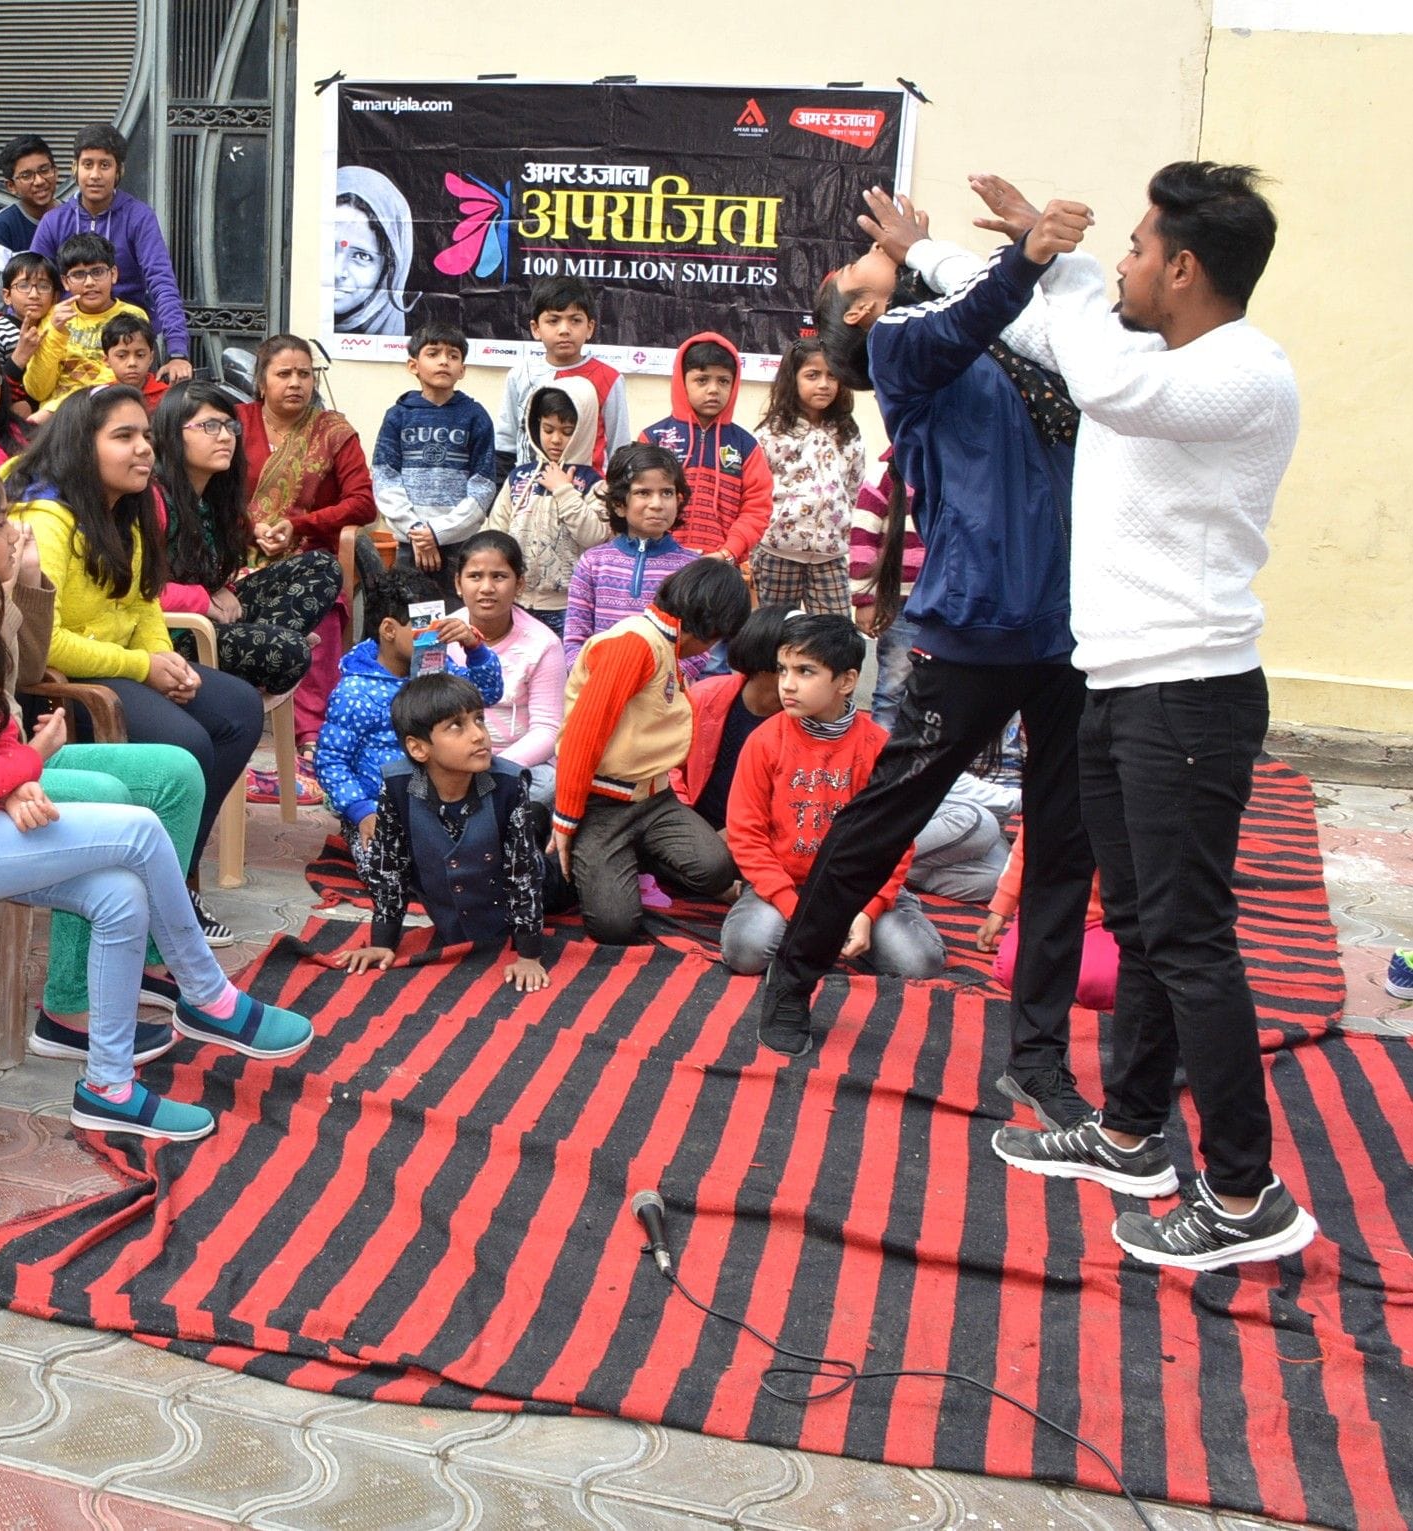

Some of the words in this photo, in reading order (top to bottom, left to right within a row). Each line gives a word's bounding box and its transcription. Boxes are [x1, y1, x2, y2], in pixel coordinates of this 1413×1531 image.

[352, 97, 453, 115] amarujala.com
[795, 111, 830, 126] अमर
[831, 113, 876, 128] उजाला
[521, 161, 577, 184] अमर
[577, 164, 650, 186] उजाला
[518, 174, 783, 248] अपराजिता
[522, 256, 558, 276] 100
[565, 257, 676, 281] MILLION
[681, 263, 778, 286] SMILES
